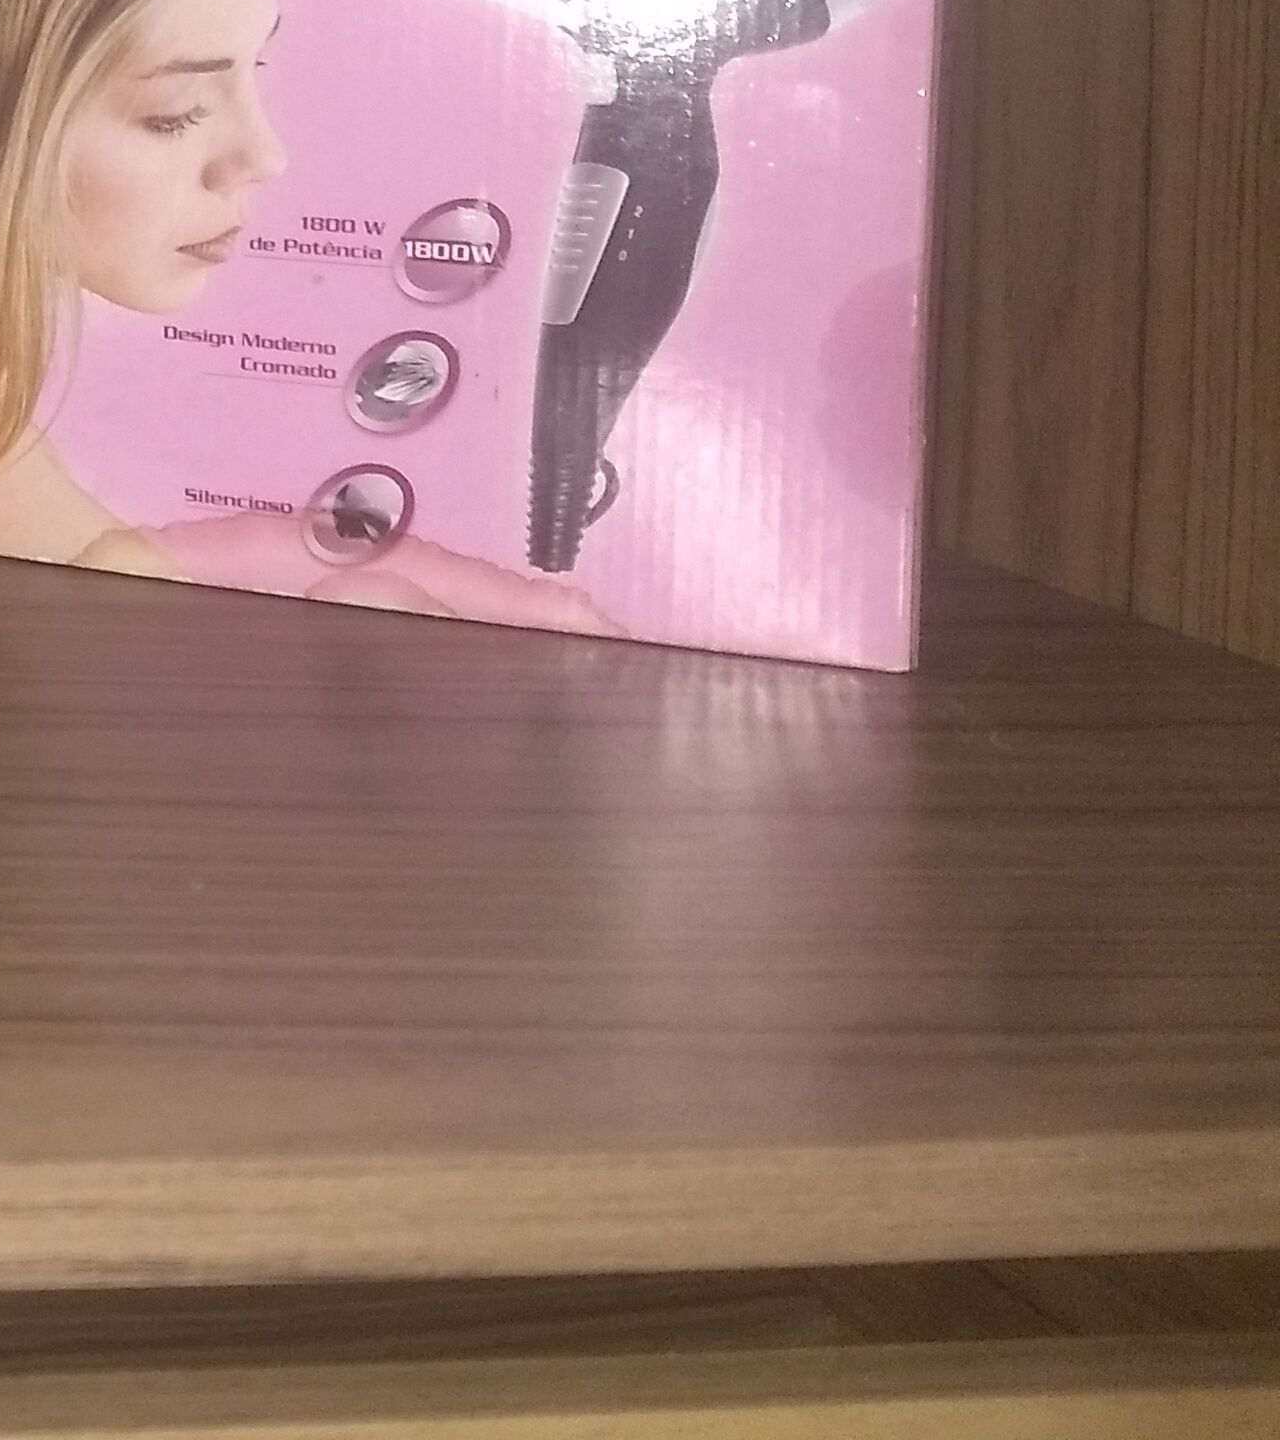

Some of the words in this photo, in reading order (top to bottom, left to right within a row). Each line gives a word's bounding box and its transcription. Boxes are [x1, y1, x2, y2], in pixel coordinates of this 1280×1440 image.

[301, 216, 357, 234] 1800
[364, 221, 387, 236] W
[249, 235, 277, 253] de
[283, 238, 384, 261] Potência
[404, 240, 494, 264] 1800W
[163, 324, 235, 348] Design
[241, 332, 338, 356] Moderno
[240, 356, 338, 381] Cromado
[184, 487, 293, 514] Silencioso
